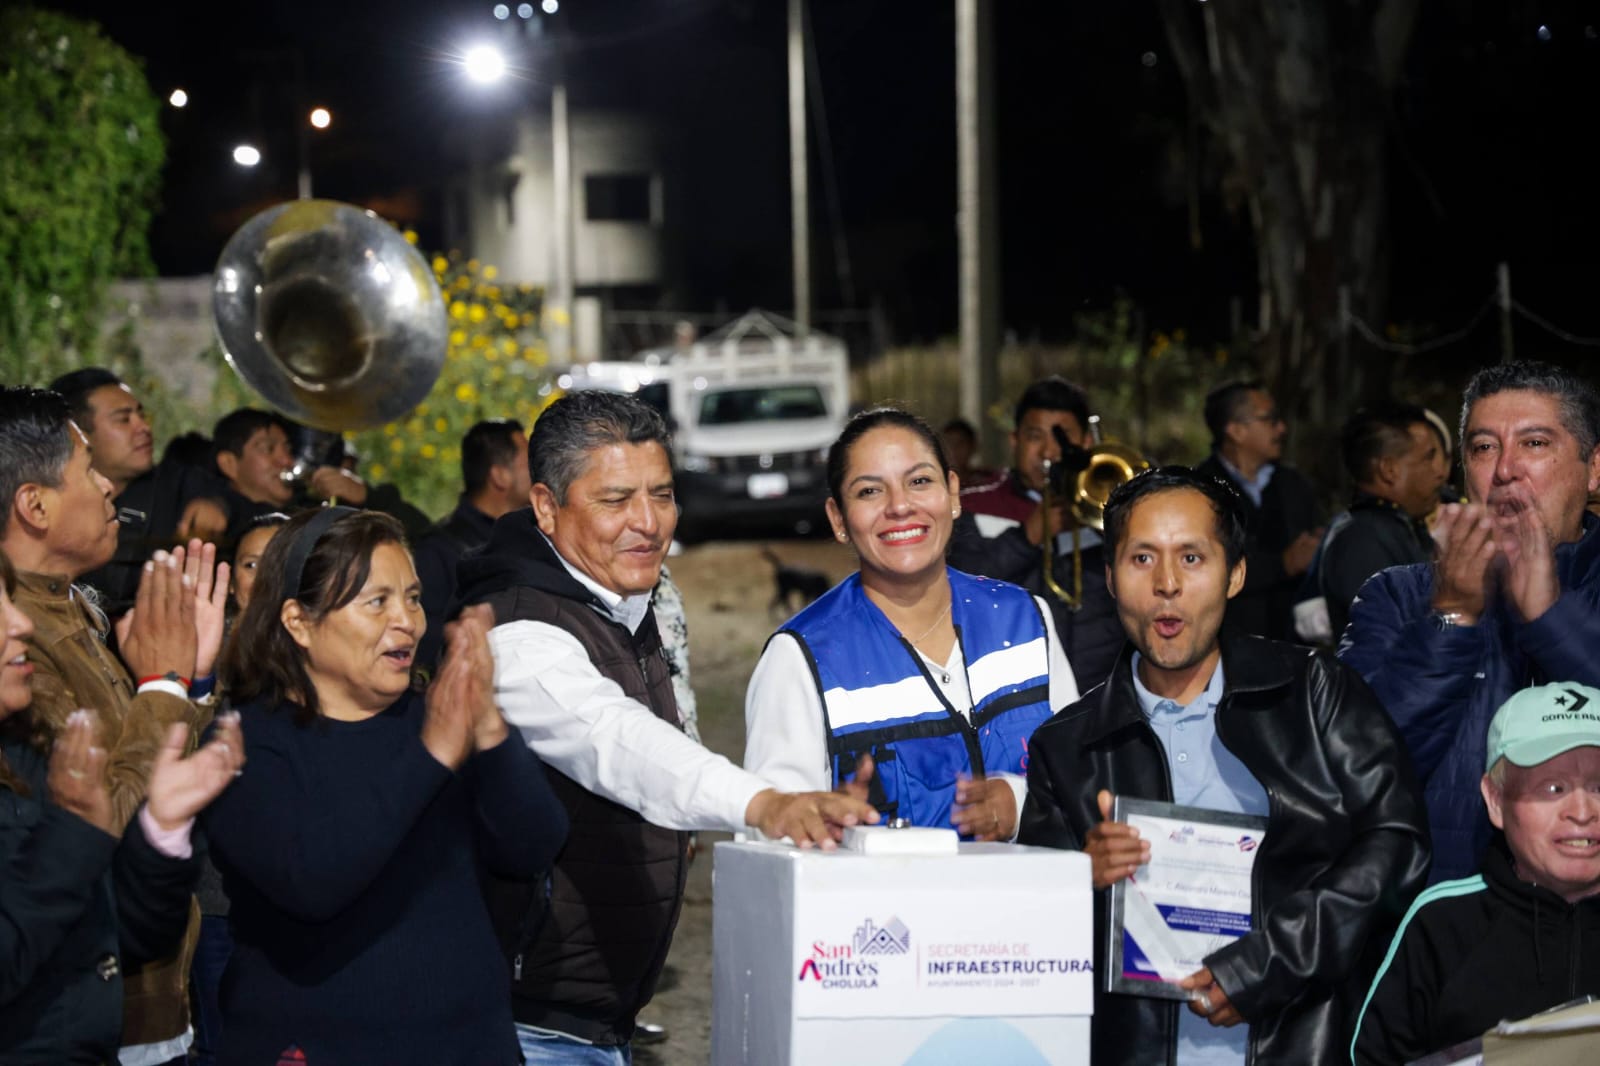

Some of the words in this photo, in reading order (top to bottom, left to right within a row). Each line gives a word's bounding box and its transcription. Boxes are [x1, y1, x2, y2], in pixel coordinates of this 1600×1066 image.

[811, 941, 852, 960] San
[928, 941, 1009, 956] SECRETARÍA
[1012, 943, 1030, 956] DE
[799, 957, 879, 981] Andrés
[927, 959, 1094, 974] INFRAESTRUCTURA
[821, 979, 879, 989] CHOLULA
[927, 979, 992, 987] AYUNTAMIENTO
